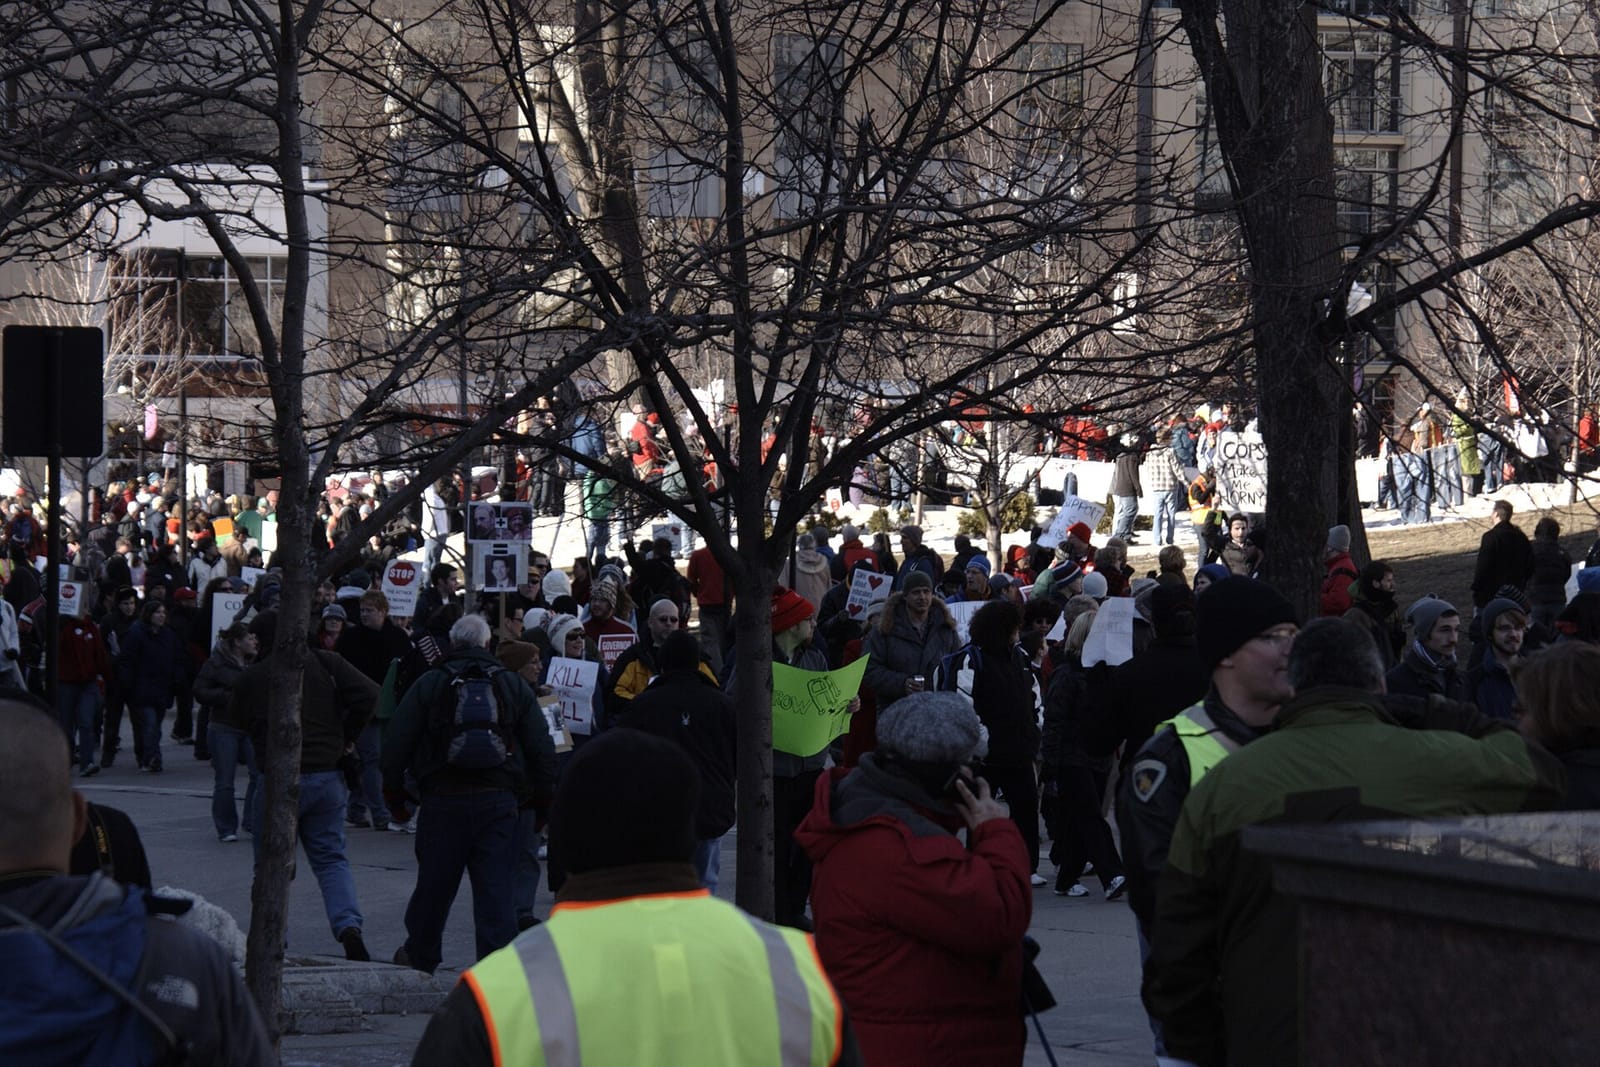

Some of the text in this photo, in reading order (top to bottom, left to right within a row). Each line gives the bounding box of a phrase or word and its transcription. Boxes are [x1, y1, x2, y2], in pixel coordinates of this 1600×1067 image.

[1223, 441, 1266, 461] COPS
[389, 567, 415, 579] STOP
[551, 665, 584, 689] KILL
